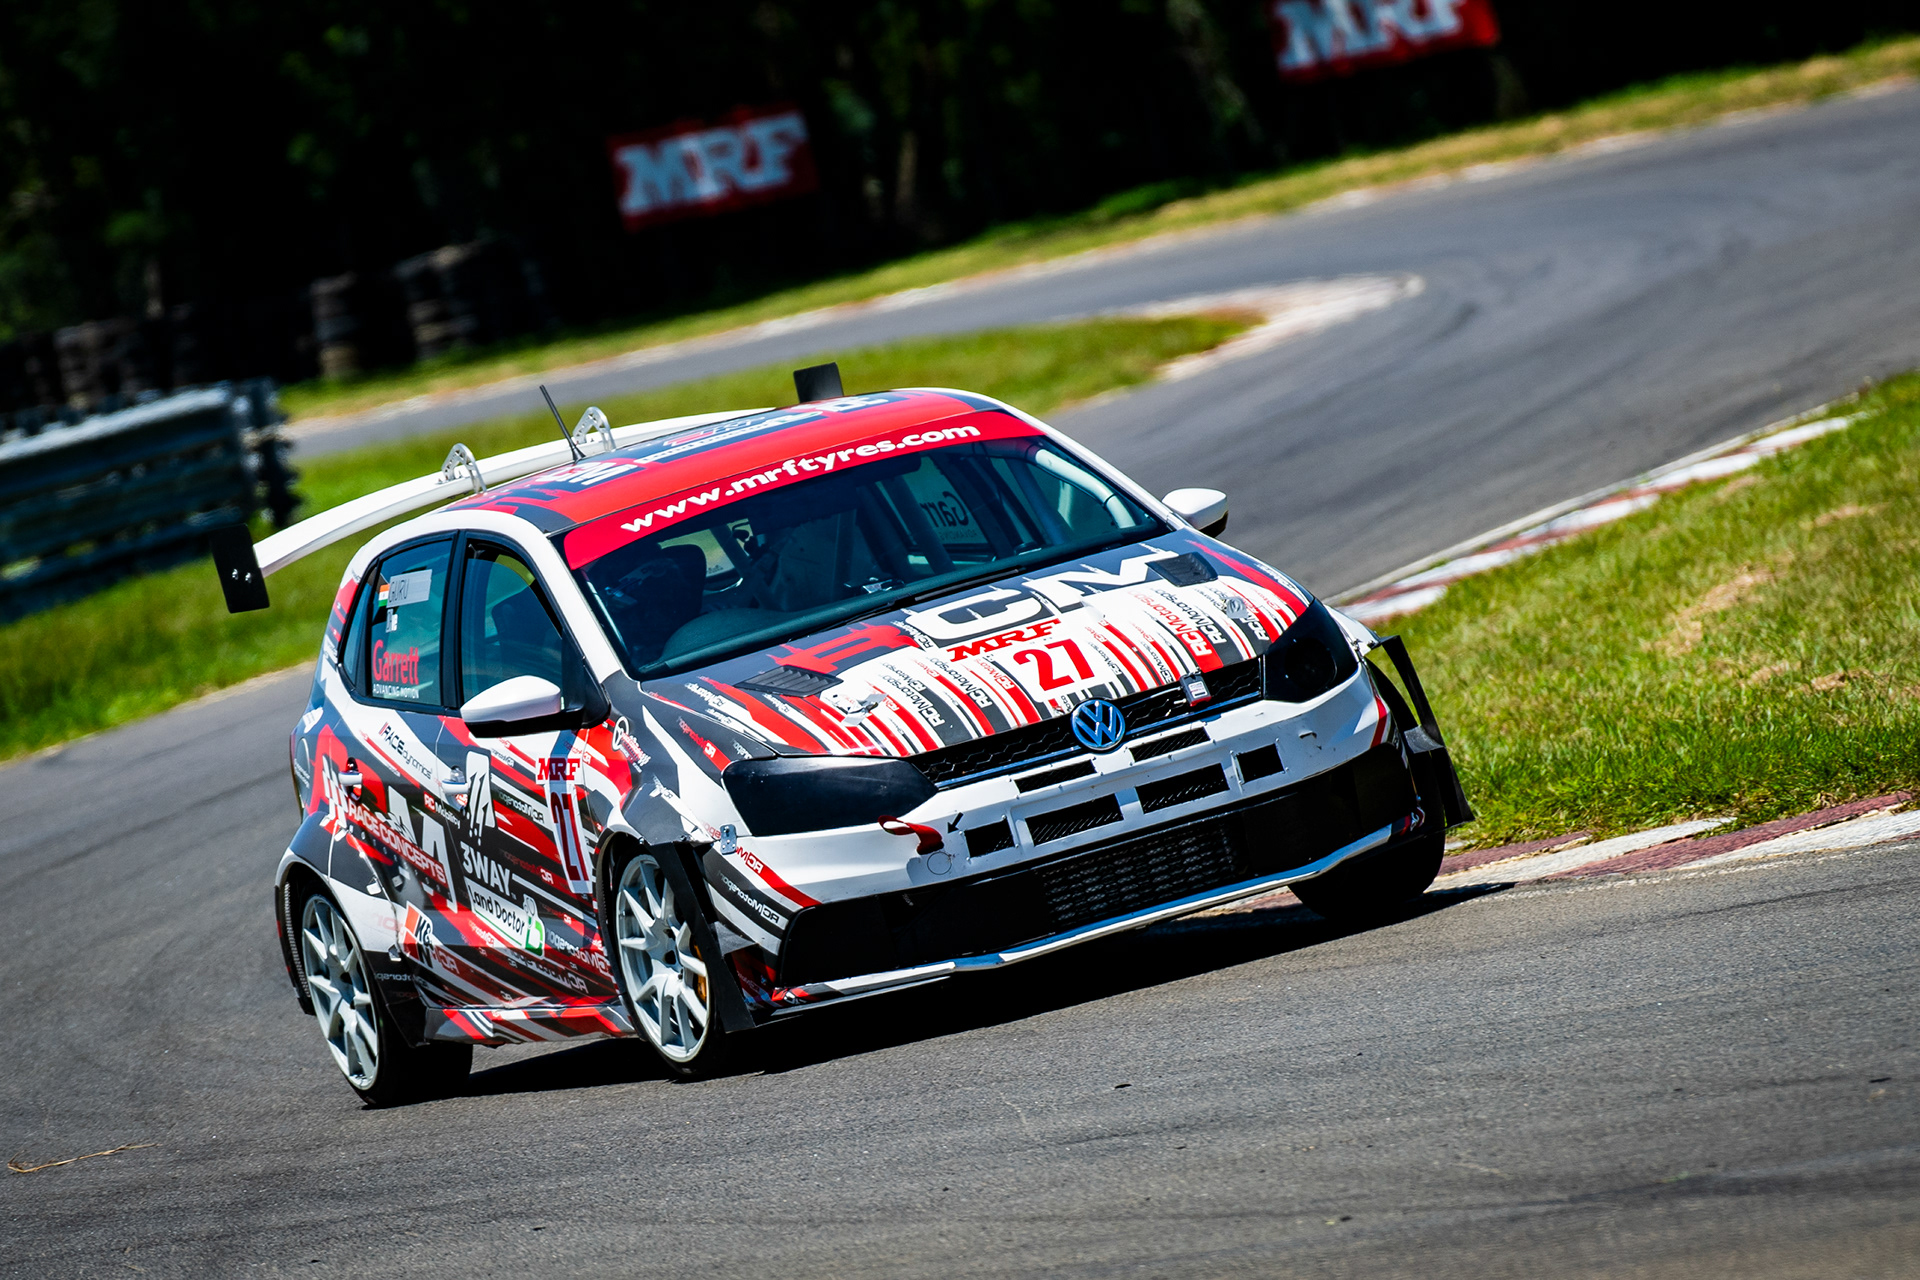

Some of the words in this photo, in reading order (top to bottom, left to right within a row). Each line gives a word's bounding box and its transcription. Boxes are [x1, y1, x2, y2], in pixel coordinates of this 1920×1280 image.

[616, 111, 808, 215] MRF
[619, 421, 982, 534] www.mrftyres.com
[372, 639, 419, 685] Garrett
[946, 617, 1062, 662] MRF
[1012, 638, 1095, 692] 27
[373, 683, 399, 697] ADVANCING
[537, 757, 581, 781] MRF
[550, 791, 589, 882] 27
[468, 884, 494, 915] Land
[494, 900, 526, 936] Doctor
